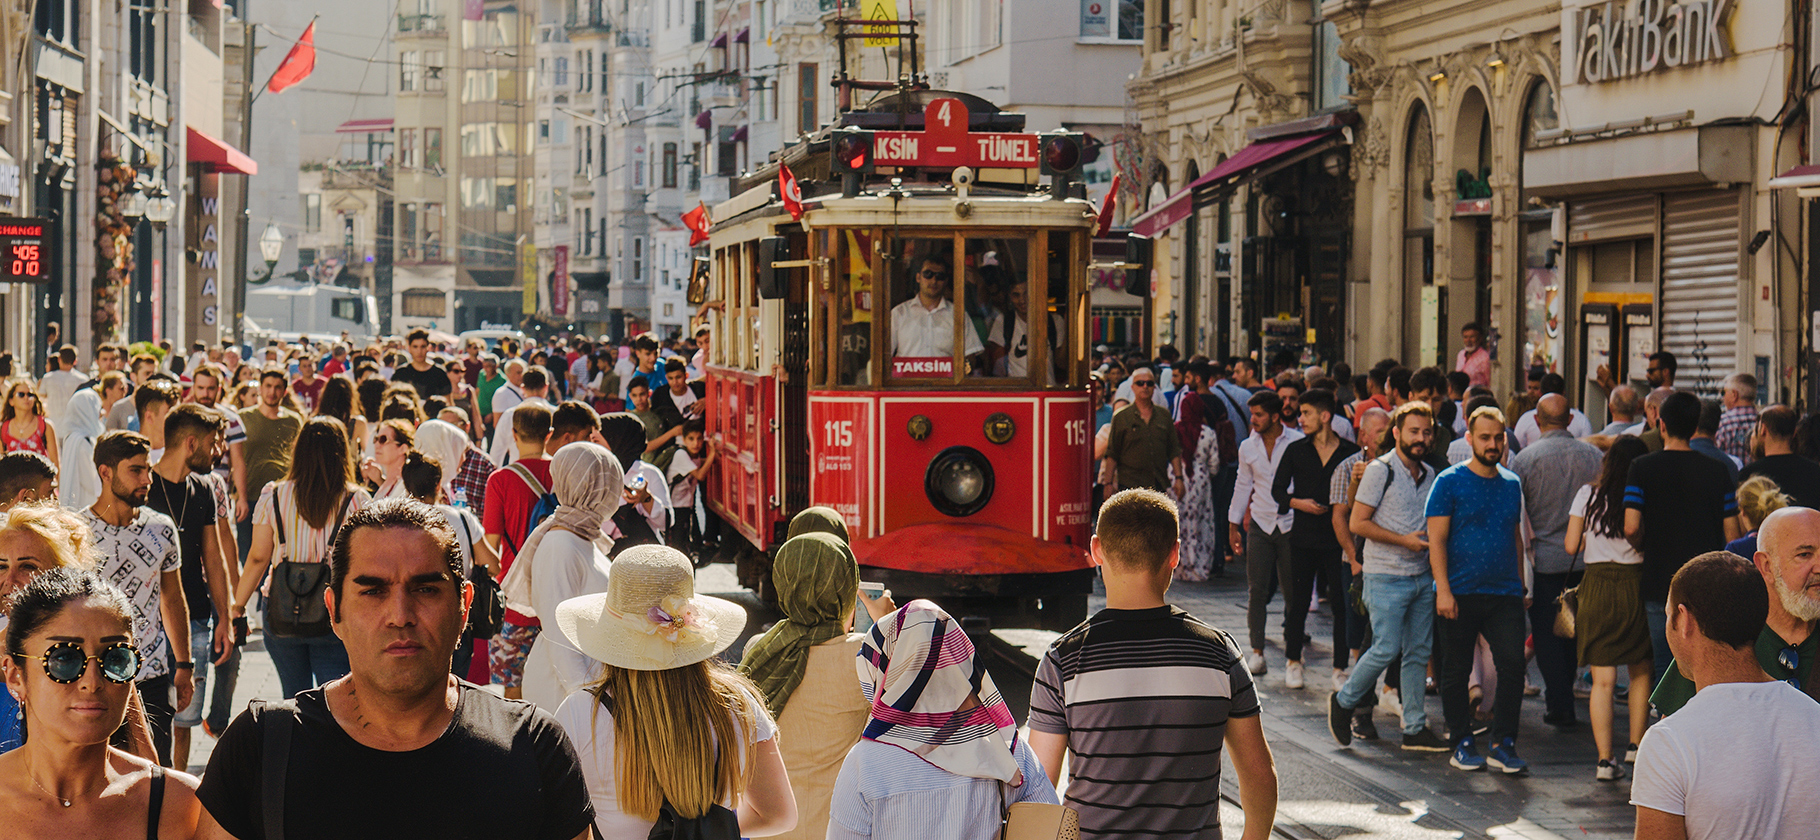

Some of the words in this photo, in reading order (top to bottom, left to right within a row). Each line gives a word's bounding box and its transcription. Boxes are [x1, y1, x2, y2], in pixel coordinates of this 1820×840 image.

[870, 24, 891, 35] 600
[937, 101, 951, 127] 4
[977, 135, 1036, 162] TÜNEL
[12, 245, 39, 260] 405
[201, 197, 219, 325] WAMAS
[894, 360, 952, 373] TAKSİM
[825, 420, 852, 447] 115
[1064, 420, 1085, 446] 115
